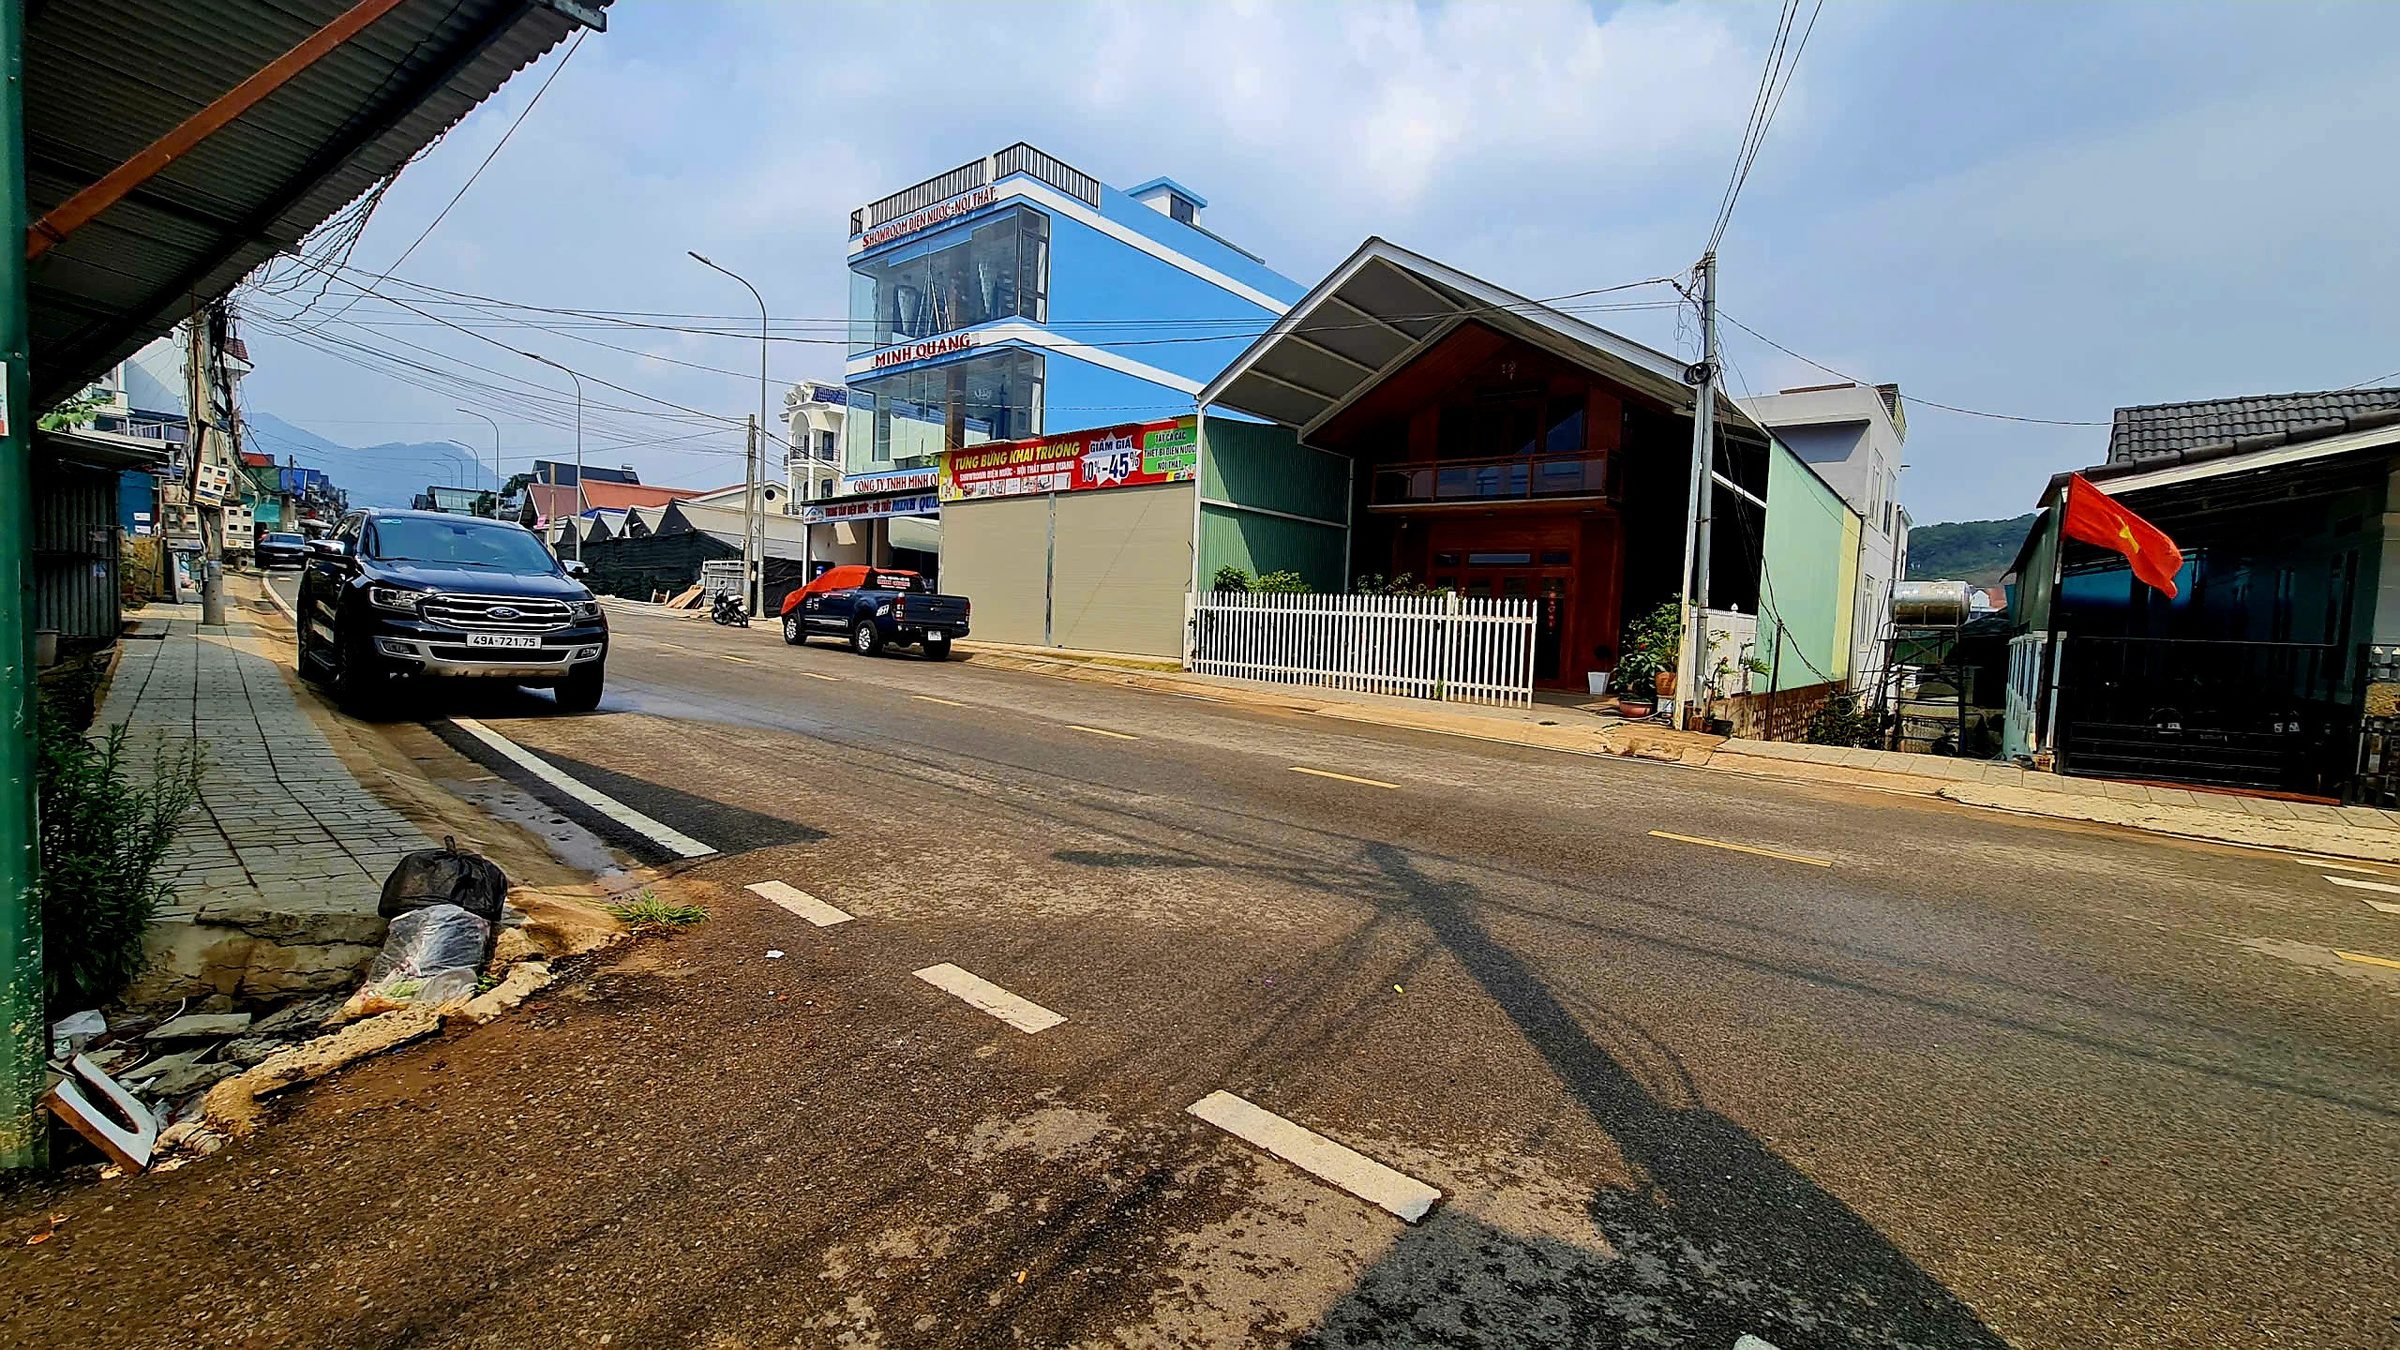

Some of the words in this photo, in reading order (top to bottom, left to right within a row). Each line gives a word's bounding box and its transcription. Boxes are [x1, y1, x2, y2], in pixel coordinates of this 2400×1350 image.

[862, 221, 908, 248] SHOWROOM
[875, 346, 912, 367] MINH
[915, 332, 970, 360] QUANG
[1116, 436, 1131, 449] GIÁ
[1009, 447, 1034, 464] KHAI
[853, 477, 875, 493] CÔNG
[876, 478, 886, 491] TY
[887, 474, 907, 491] TNHH
[908, 473, 929, 488] MINH
[473, 636, 536, 647] 49A-721.75
